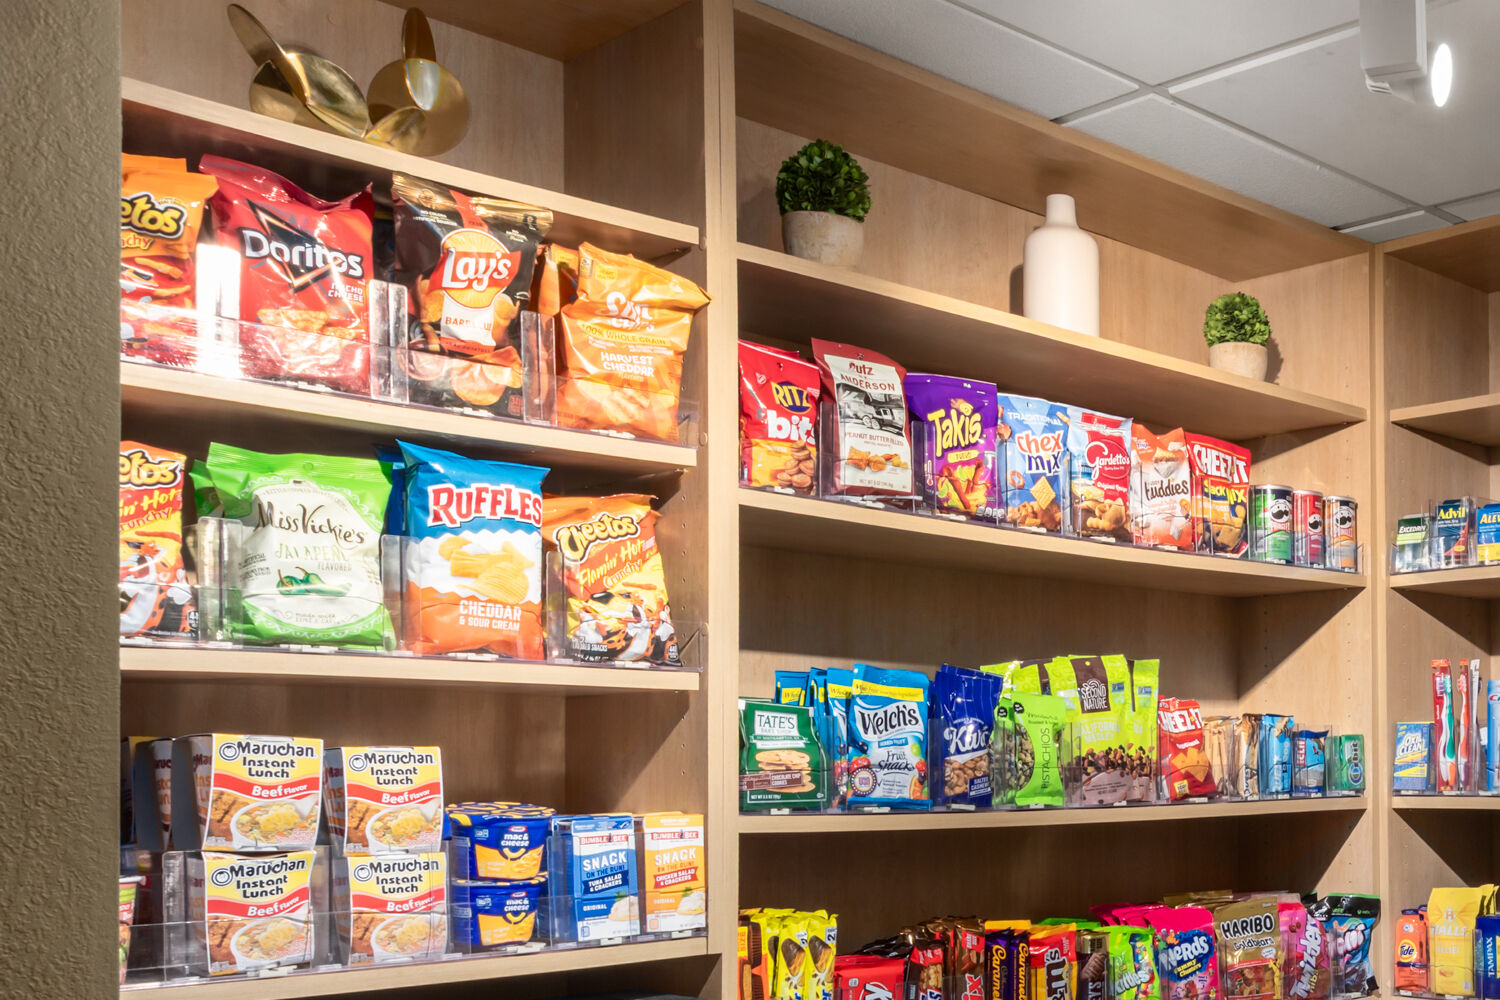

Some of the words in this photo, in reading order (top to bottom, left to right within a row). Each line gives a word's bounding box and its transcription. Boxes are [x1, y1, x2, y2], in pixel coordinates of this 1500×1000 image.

[242, 229, 364, 278] Doritos
[442, 247, 512, 292] Lay's
[601, 352, 654, 365] HARVEST
[603, 361, 655, 377] CHEDDAR
[840, 373, 896, 392] ANDERSON
[771, 381, 813, 408] RITZ
[928, 408, 983, 458] Takis
[1085, 441, 1131, 481] Gardetto's
[429, 486, 542, 526] RUFFLES
[1437, 507, 1466, 520] Advil
[298, 503, 366, 546] Vickie's
[557, 514, 638, 561] Cheetos
[620, 539, 645, 561] Hot
[603, 559, 642, 588] Crunchy
[459, 599, 522, 622] CHEDDAR
[468, 616, 491, 630] SOUR
[492, 618, 521, 632] CREAM
[1080, 683, 1107, 700] SECOND
[1083, 697, 1108, 712] NATURE
[757, 714, 795, 730] TATE'S
[858, 704, 920, 736] Welch's
[237, 740, 315, 757] Maruchan
[242, 757, 296, 769] Instant
[364, 752, 434, 766] Maruchan
[1040, 727, 1051, 789] PISTACHIOS
[248, 767, 290, 779] Lunch
[370, 766, 418, 777] Instant
[376, 776, 414, 786] Lunch
[251, 785, 284, 799] Beef
[284, 783, 308, 795] Flavor
[381, 792, 409, 805] Beef
[409, 788, 431, 801] Flavor
[580, 835, 608, 845] BUMBLE
[612, 834, 629, 842] BEE
[652, 832, 679, 840] BUMBLE
[684, 831, 699, 839] BEE
[582, 851, 628, 872] SNACK
[655, 848, 697, 867] SNACK
[229, 858, 306, 878] Maruchan
[369, 859, 439, 876] Maruchan
[586, 871, 596, 879] ON
[596, 868, 609, 876] THE
[609, 864, 625, 874] RUN!
[656, 873, 677, 882] CHICKEN
[677, 868, 695, 878] SALAD
[236, 876, 288, 890] Instant
[375, 874, 424, 886] Instant
[588, 878, 603, 888] TUNA
[604, 874, 623, 883] SALAD
[594, 880, 623, 892] CRACKERS
[664, 875, 692, 886] CRACKERS
[242, 887, 284, 900] Lunch
[381, 884, 419, 894] Lunch
[247, 904, 279, 918] Beef
[279, 896, 300, 910] Flavor
[386, 900, 414, 913] Beef
[1220, 912, 1275, 940] HARIBO
[1429, 924, 1467, 937] HALLS
[1233, 936, 1275, 951] Goldbears
